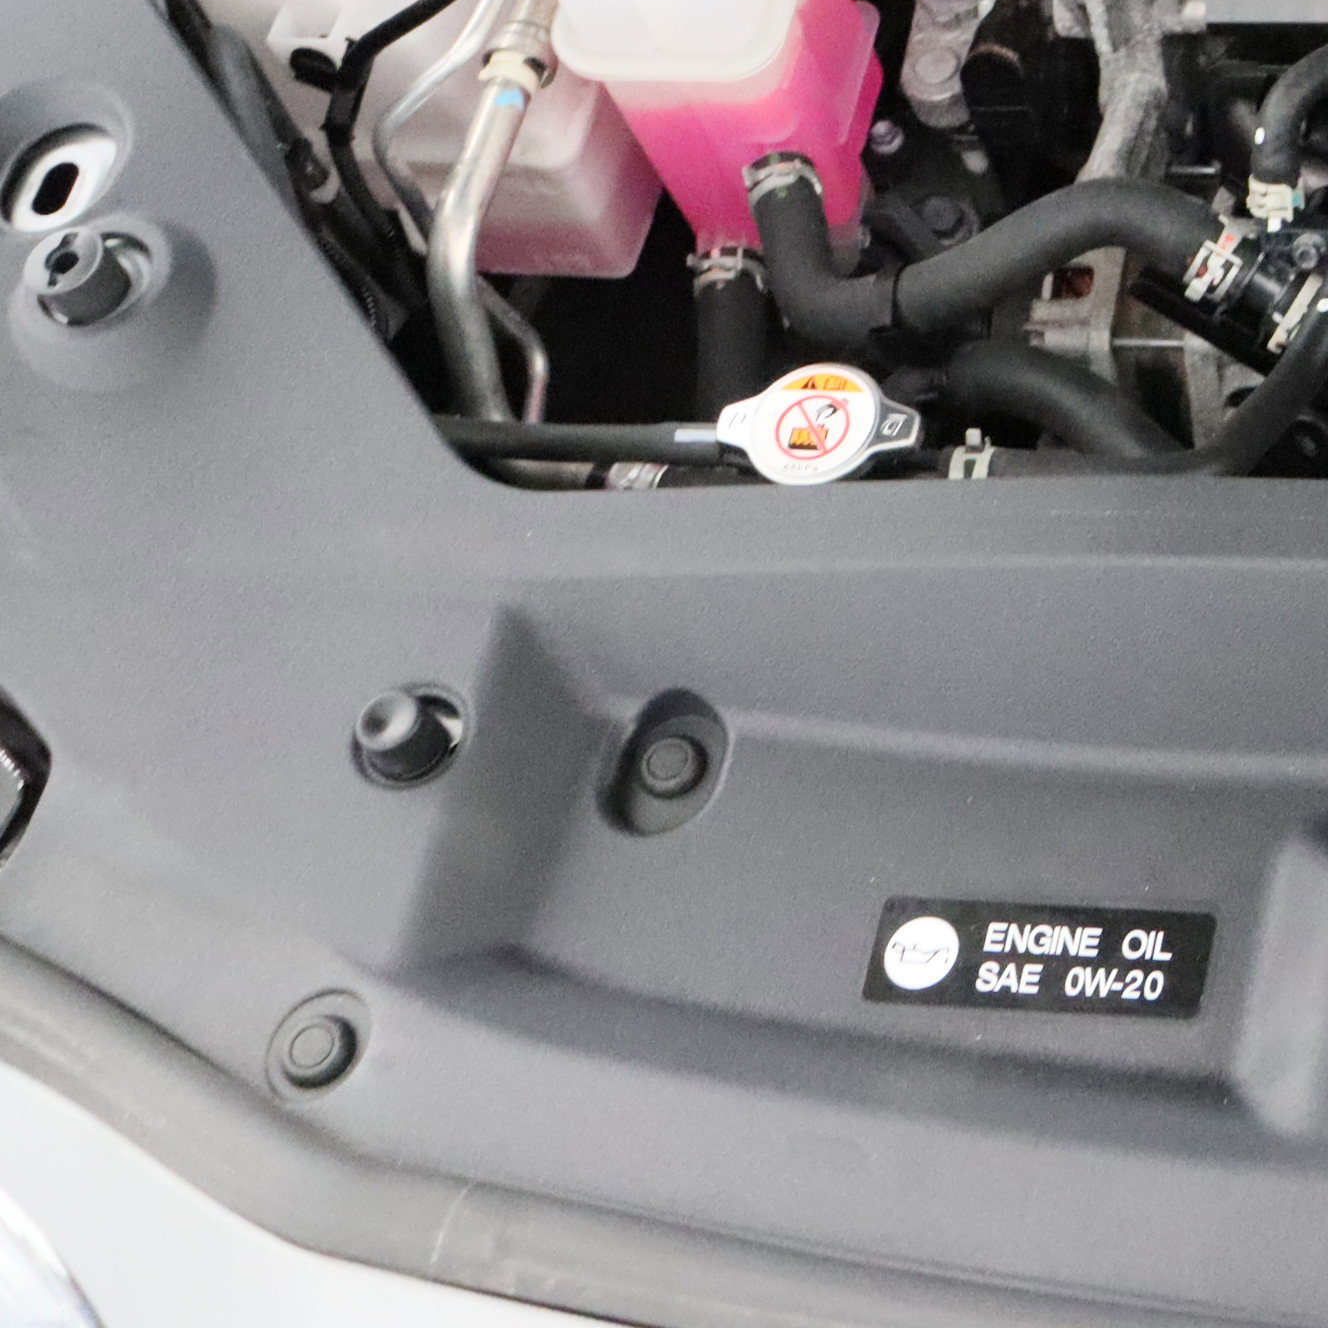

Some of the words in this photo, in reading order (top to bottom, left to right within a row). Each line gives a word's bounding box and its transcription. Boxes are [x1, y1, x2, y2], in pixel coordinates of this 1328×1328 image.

[983, 921, 1103, 958] ENGINE
[1121, 928, 1173, 961] OIL
[975, 961, 1044, 994] SAE
[1064, 966, 1165, 1001] 0W-20
